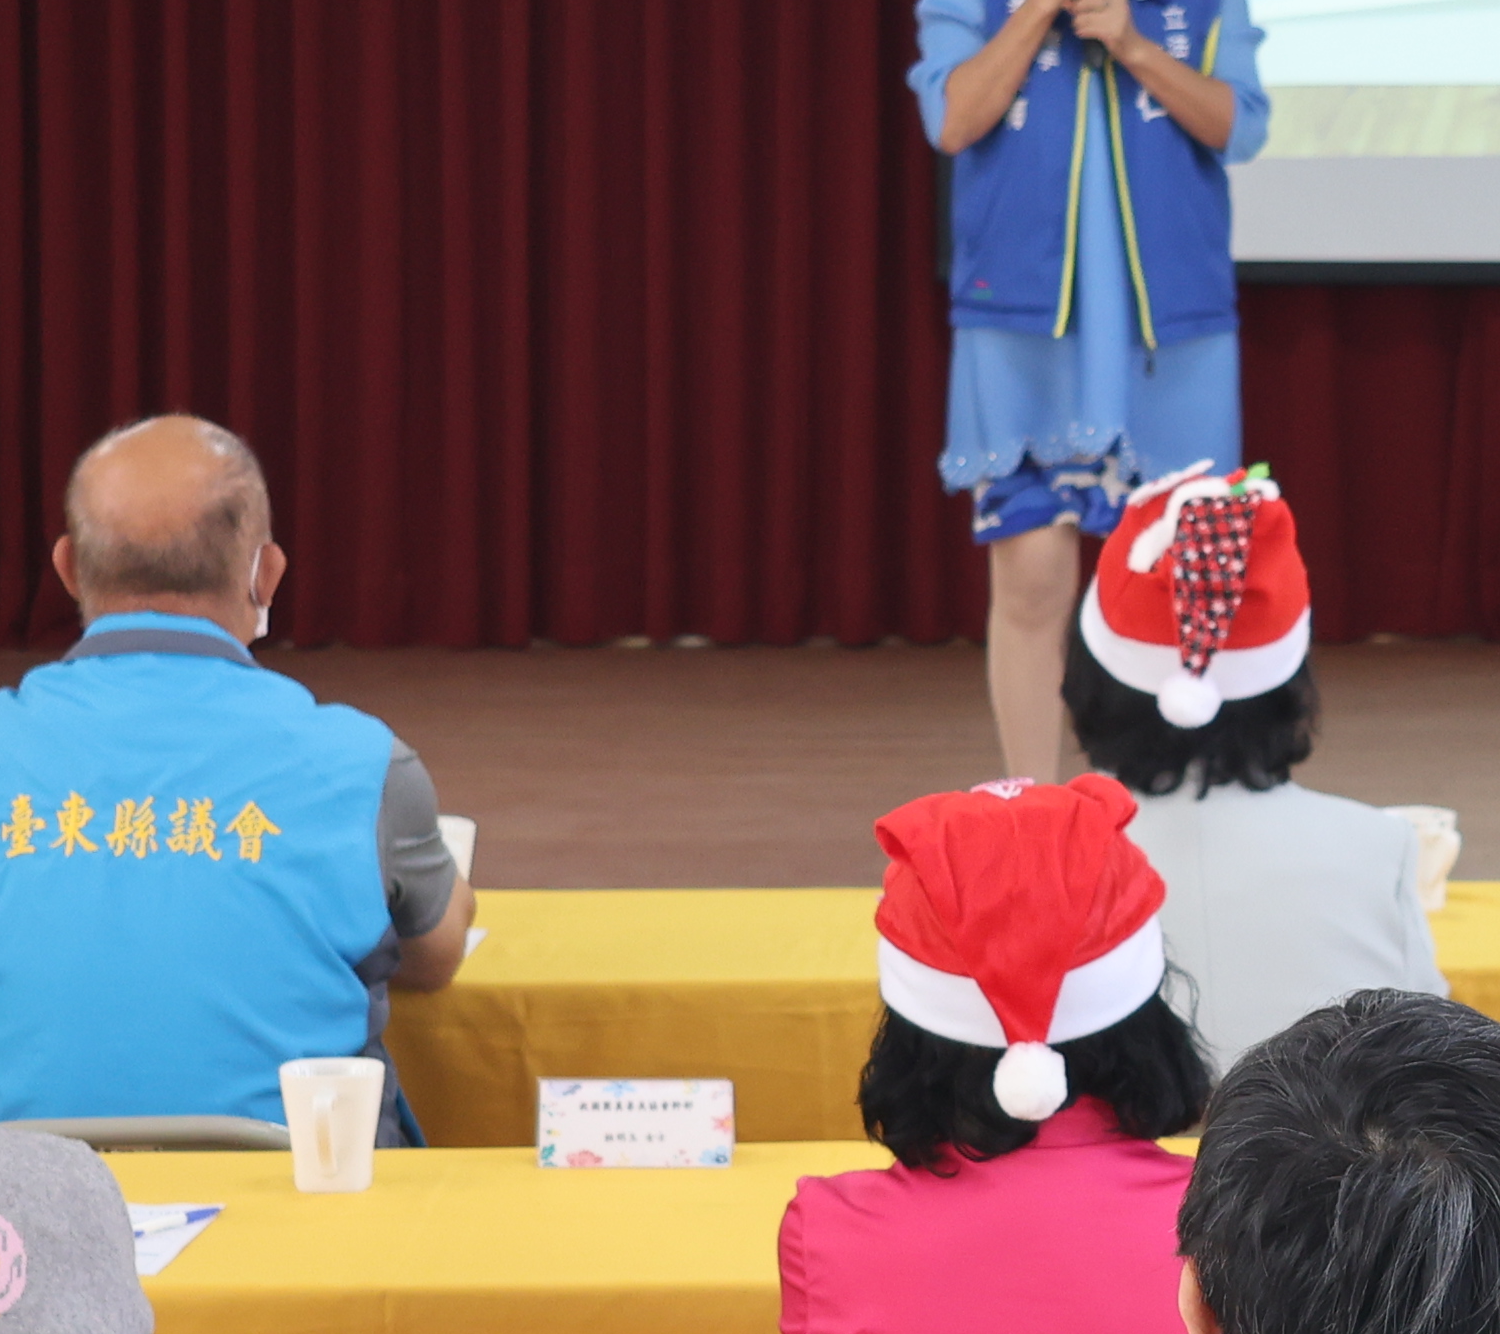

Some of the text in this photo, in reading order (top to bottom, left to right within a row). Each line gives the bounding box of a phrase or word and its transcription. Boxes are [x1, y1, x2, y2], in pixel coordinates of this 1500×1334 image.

[0, 789, 283, 865] 臺東縣議會
